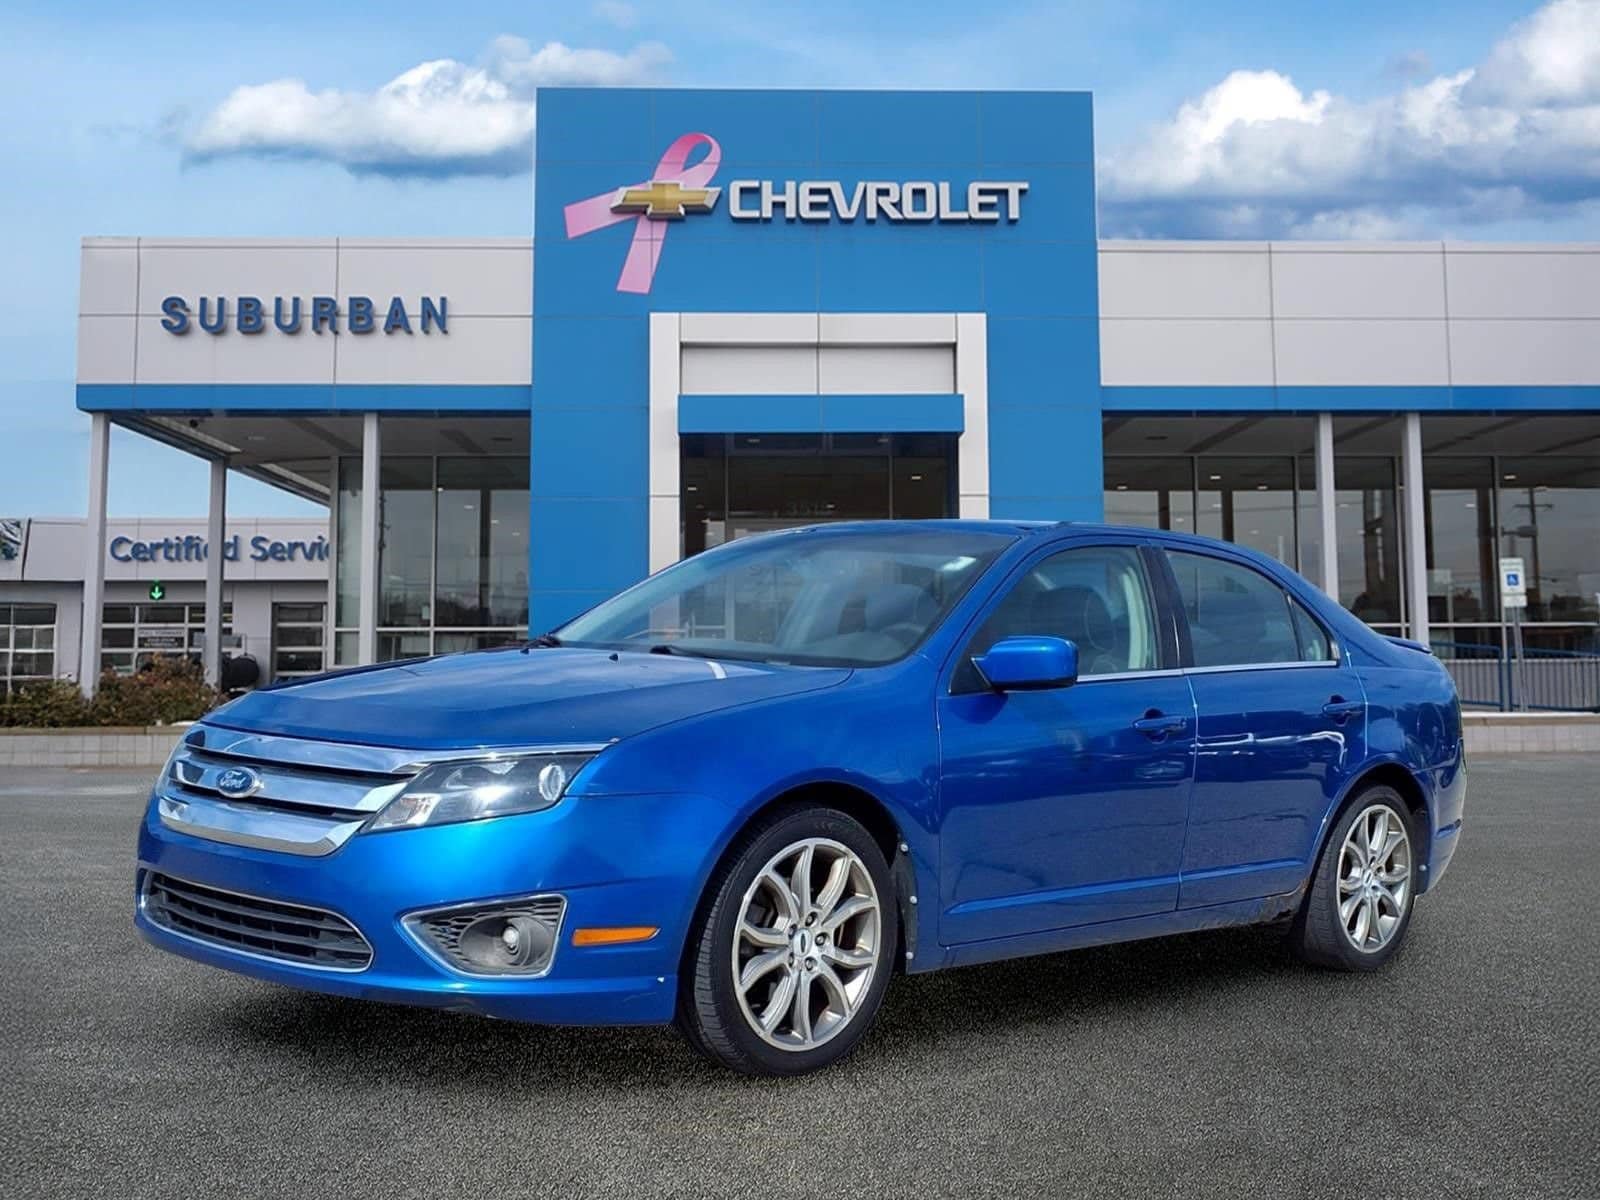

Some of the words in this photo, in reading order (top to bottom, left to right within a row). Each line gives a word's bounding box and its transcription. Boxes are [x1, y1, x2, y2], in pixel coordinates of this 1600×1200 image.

[728, 180, 1030, 222] CHEVROLET
[160, 296, 449, 335] SUBURBAN
[219, 770, 247, 789] Ford
